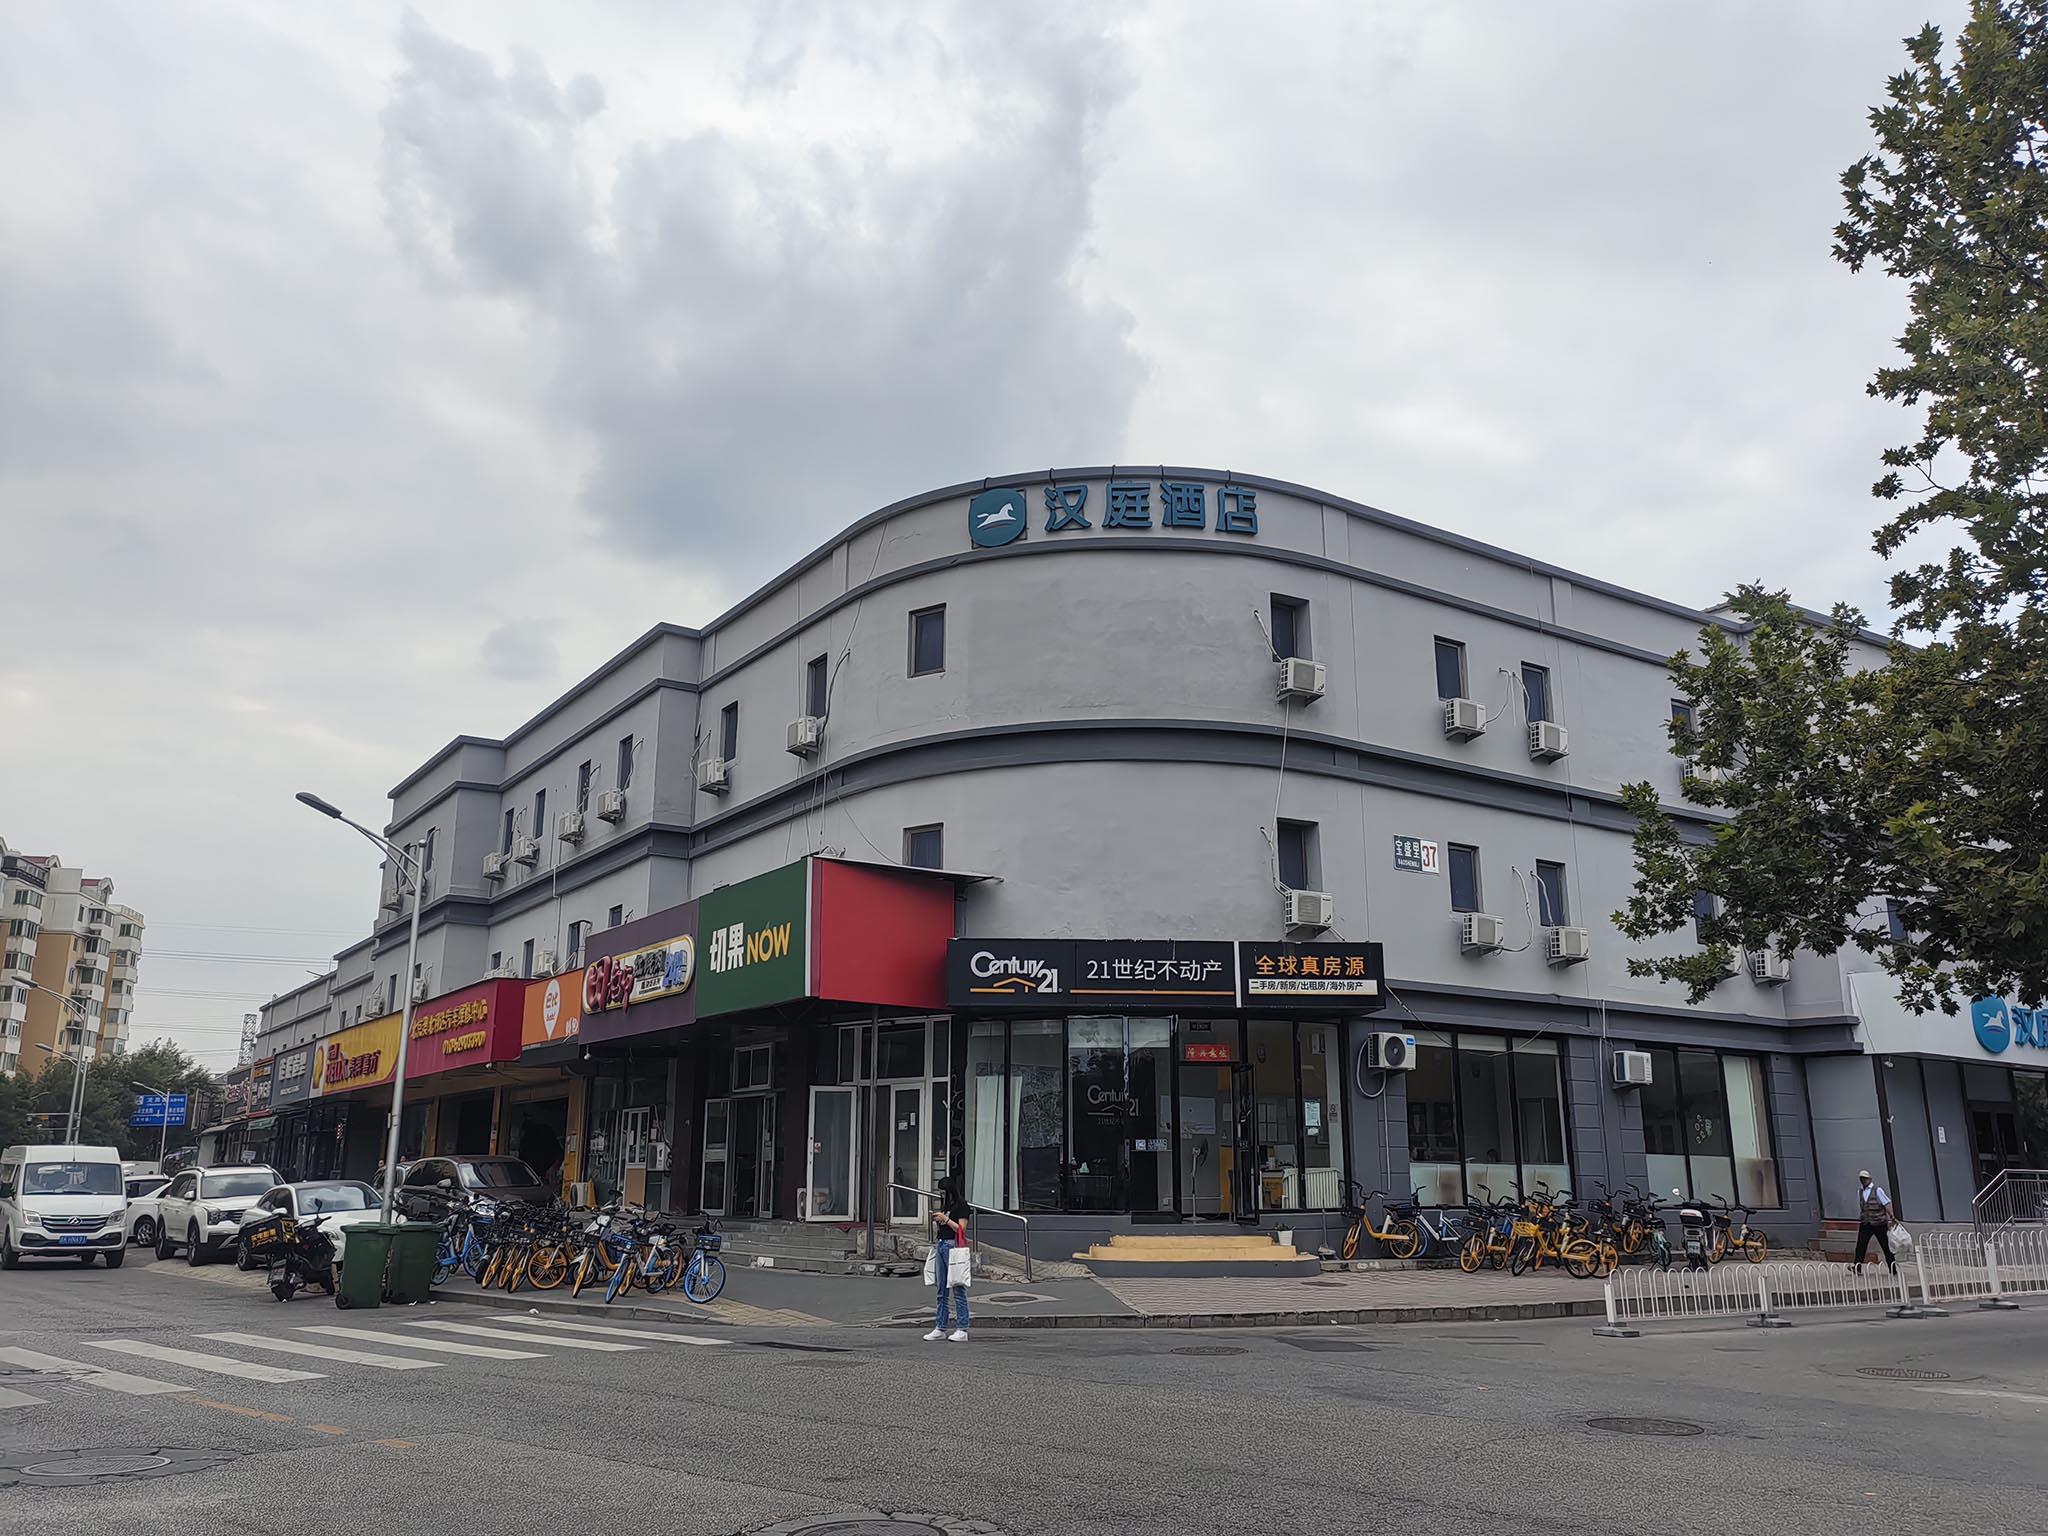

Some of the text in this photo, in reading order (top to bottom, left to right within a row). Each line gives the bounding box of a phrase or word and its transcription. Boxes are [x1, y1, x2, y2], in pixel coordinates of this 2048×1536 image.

[1044, 481, 1258, 536] 汉庭酒店
[1395, 840, 1420, 858] 宝盛里
[1422, 845, 1437, 868] 37
[709, 922, 744, 973] 切果
[746, 921, 791, 966] NOW
[970, 951, 1059, 993] Century 21
[1086, 958, 1223, 982] 21世纪不动产
[1255, 955, 1365, 976] 全球真房源
[1250, 980, 1363, 991] 二手房/新房/出租房/海外房产
